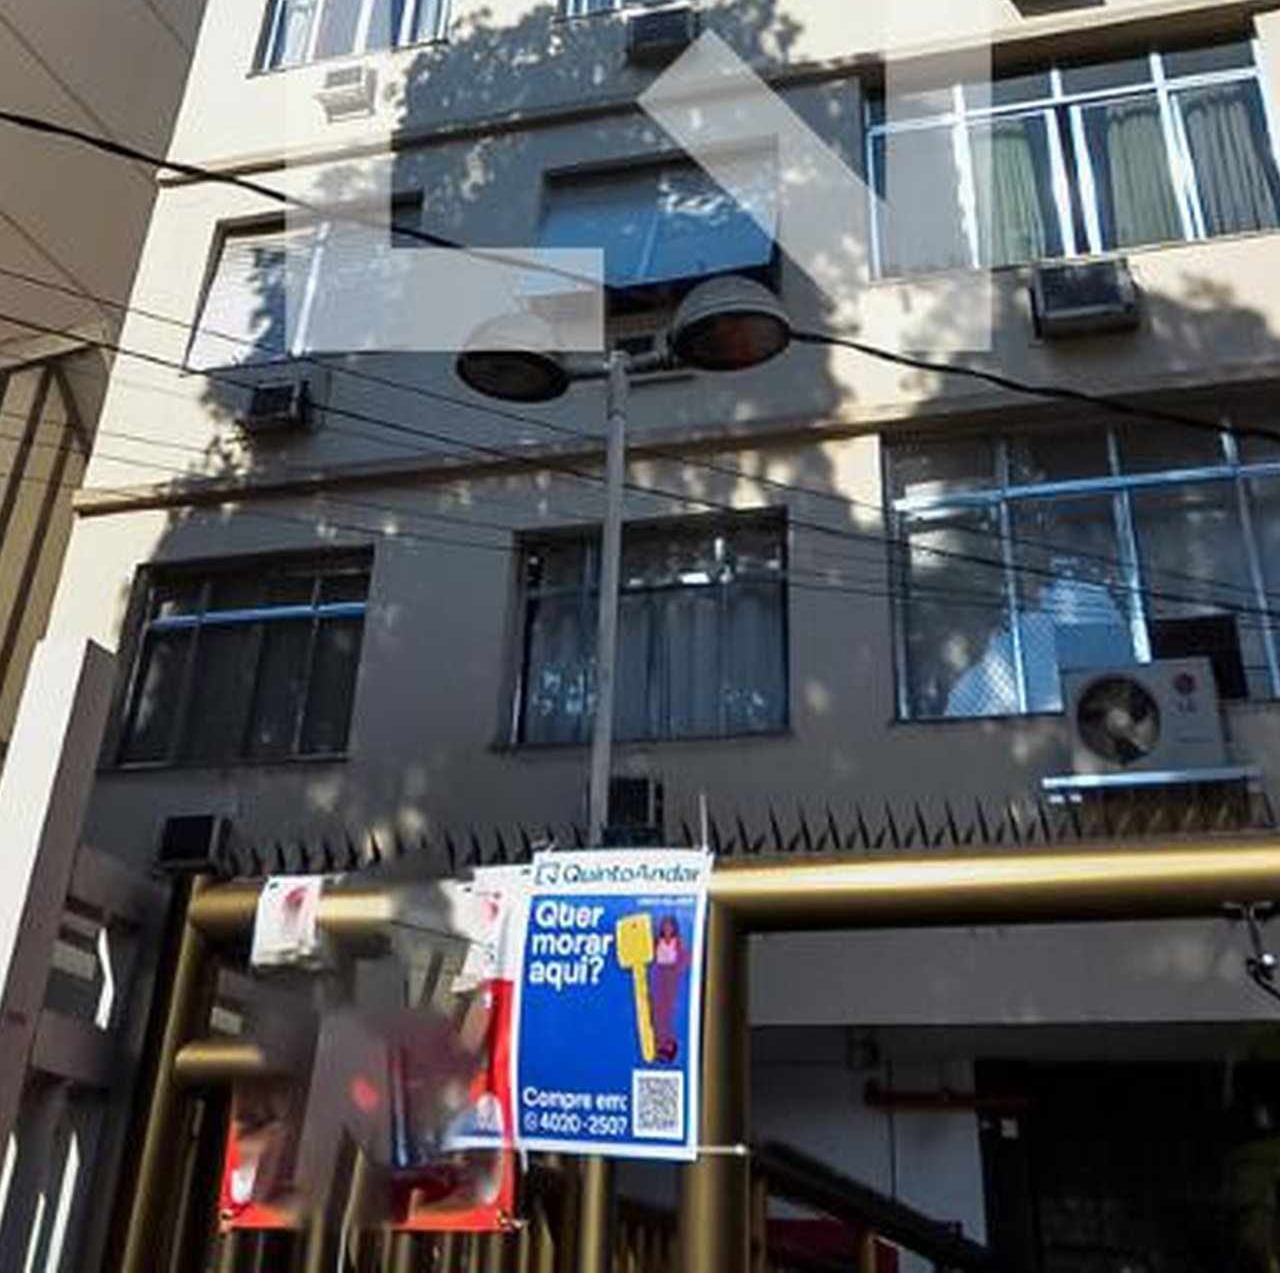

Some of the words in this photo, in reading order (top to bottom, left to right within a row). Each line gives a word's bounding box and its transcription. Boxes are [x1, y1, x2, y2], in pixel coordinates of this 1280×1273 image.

[563, 863, 699, 883] QuintoAndar
[535, 900, 605, 928] Quer
[531, 932, 613, 956] morar
[529, 955, 604, 991] aqui?
[523, 1087, 592, 1110] Compre
[595, 1093, 628, 1112] em:
